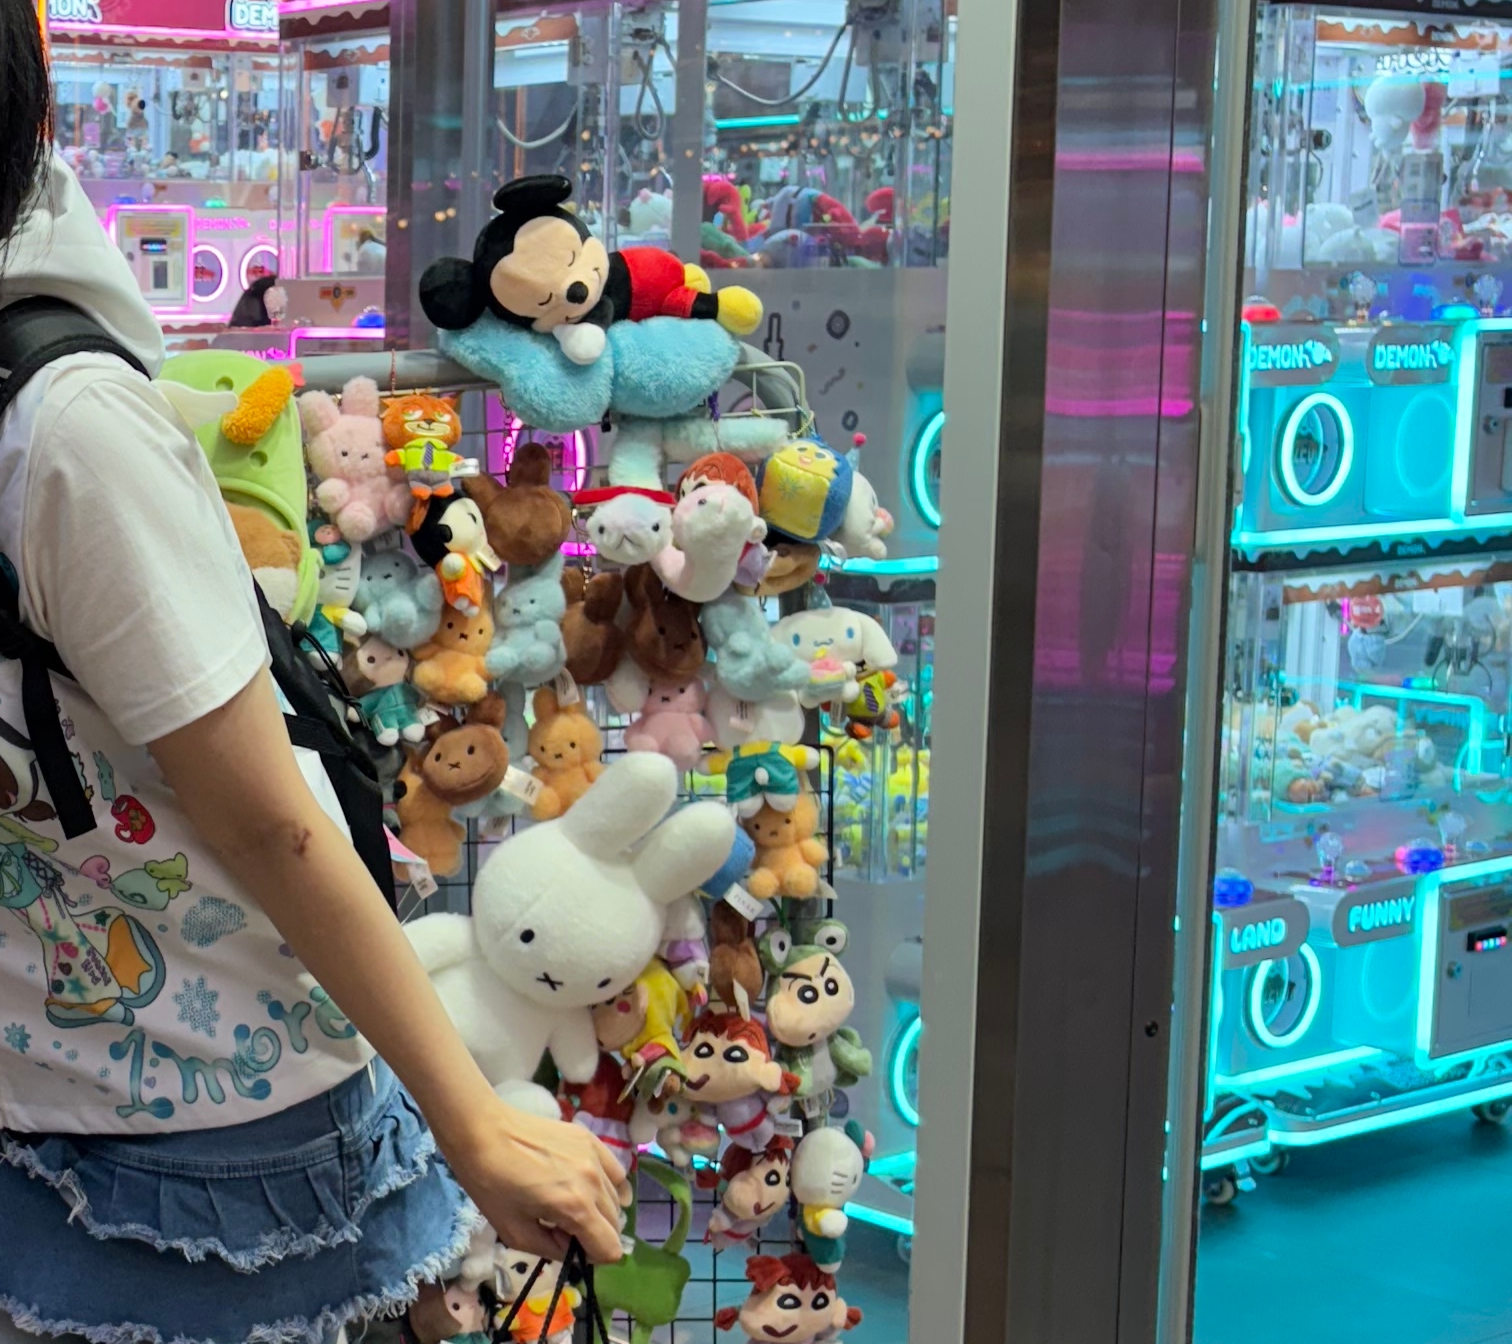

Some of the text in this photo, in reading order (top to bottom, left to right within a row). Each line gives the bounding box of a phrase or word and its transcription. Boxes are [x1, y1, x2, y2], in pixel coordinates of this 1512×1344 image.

[1249, 343, 1311, 371] DEMON
[1374, 343, 1437, 370] DEMON
[1348, 895, 1416, 934] FUNNY
[1228, 917, 1287, 954] LAND
